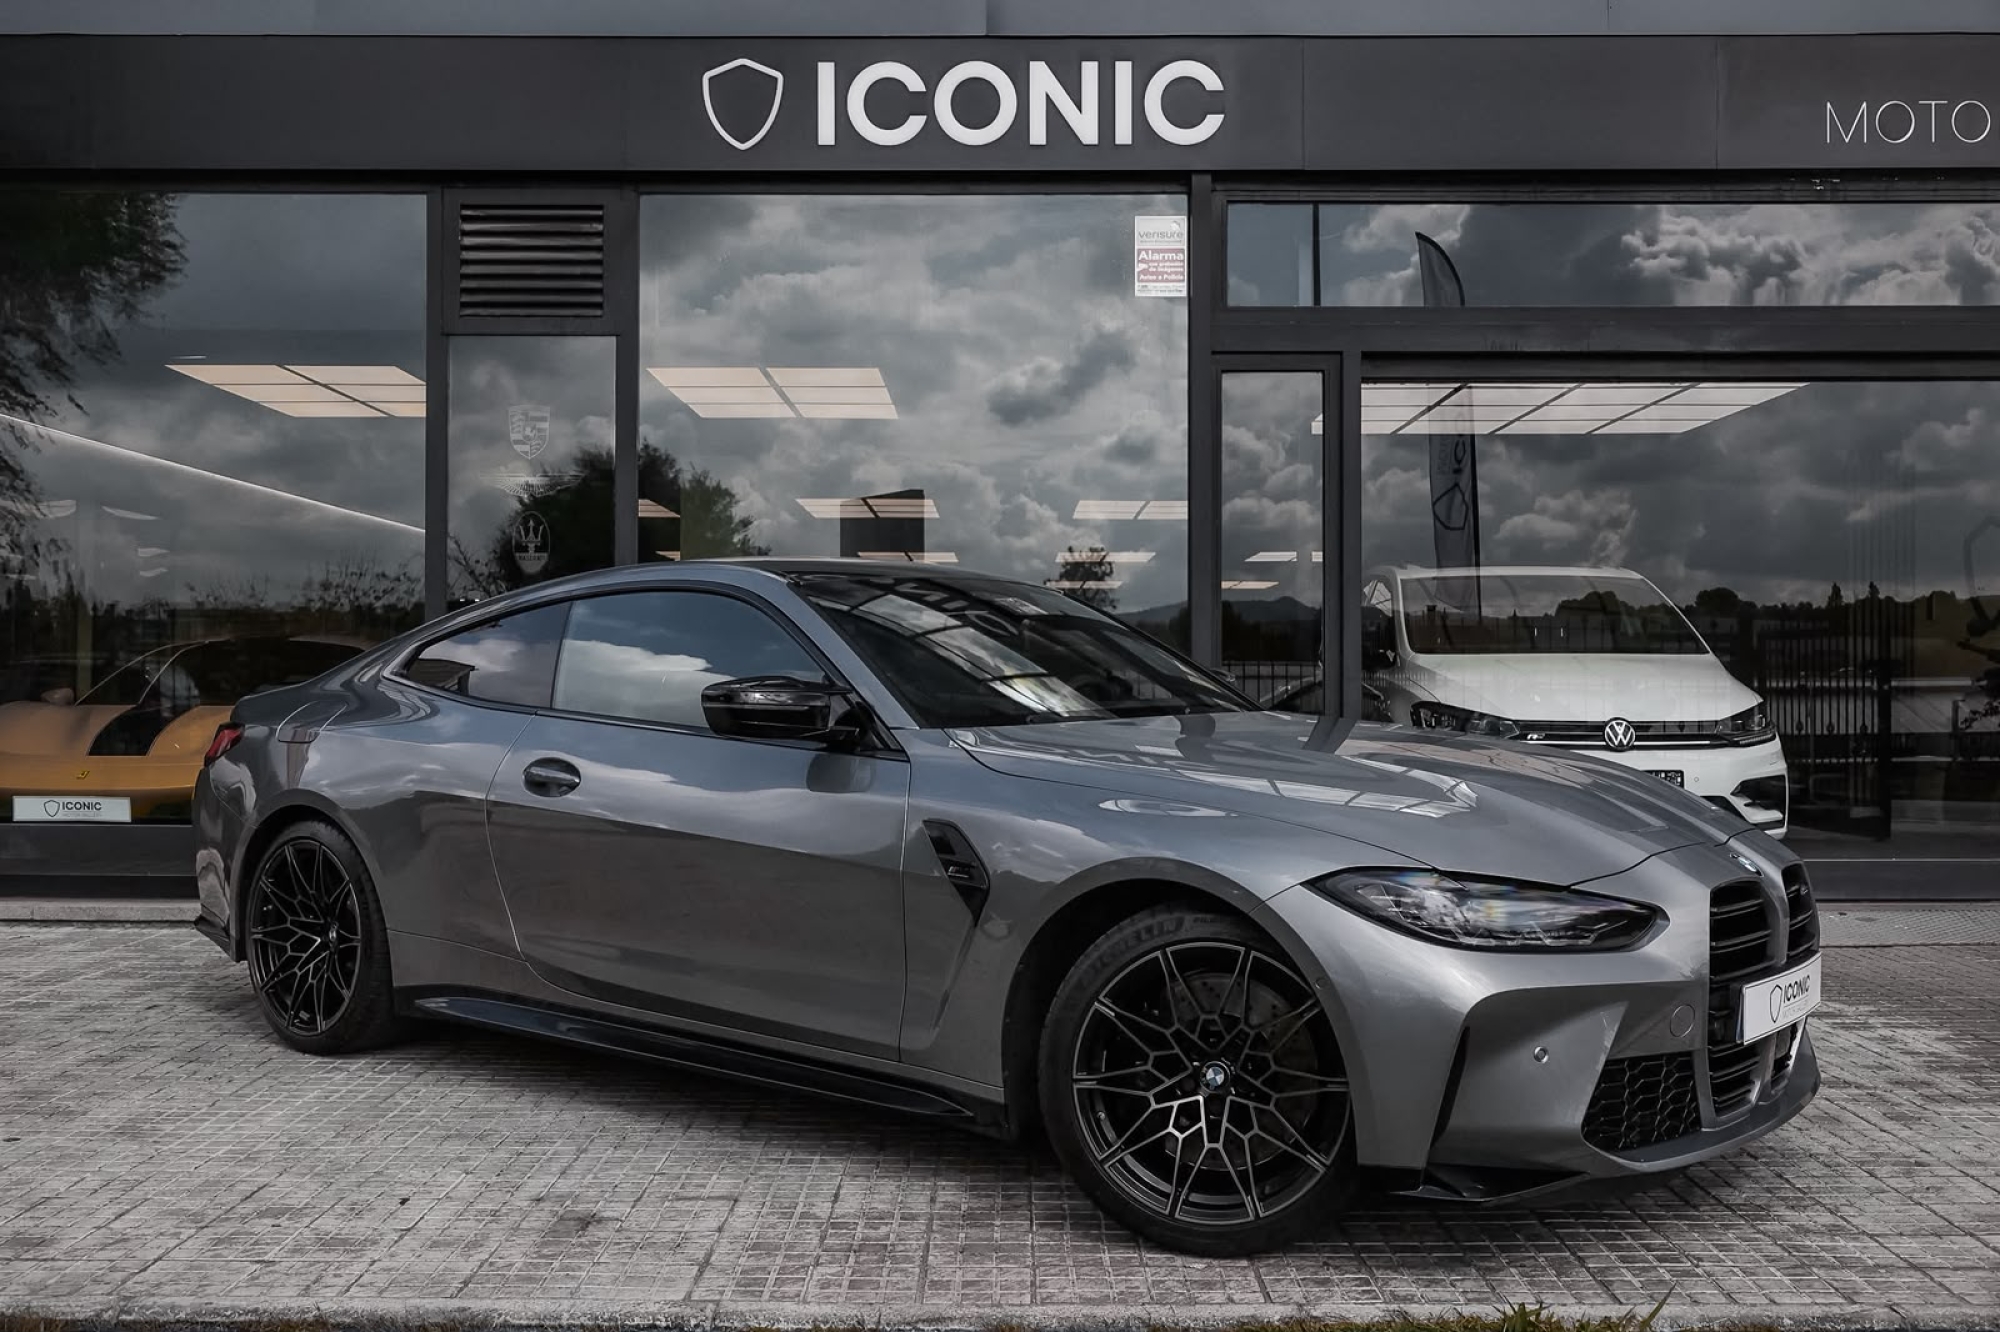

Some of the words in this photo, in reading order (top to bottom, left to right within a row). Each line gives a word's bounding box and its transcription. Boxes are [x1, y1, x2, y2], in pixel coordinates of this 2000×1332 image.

[816, 60, 1225, 146] ICONIC
[1138, 230, 1184, 239] verisure
[1138, 249, 1184, 261] Alarma
[62, 801, 102, 811] ICONIC
[1783, 974, 1811, 1003] ICONIC
